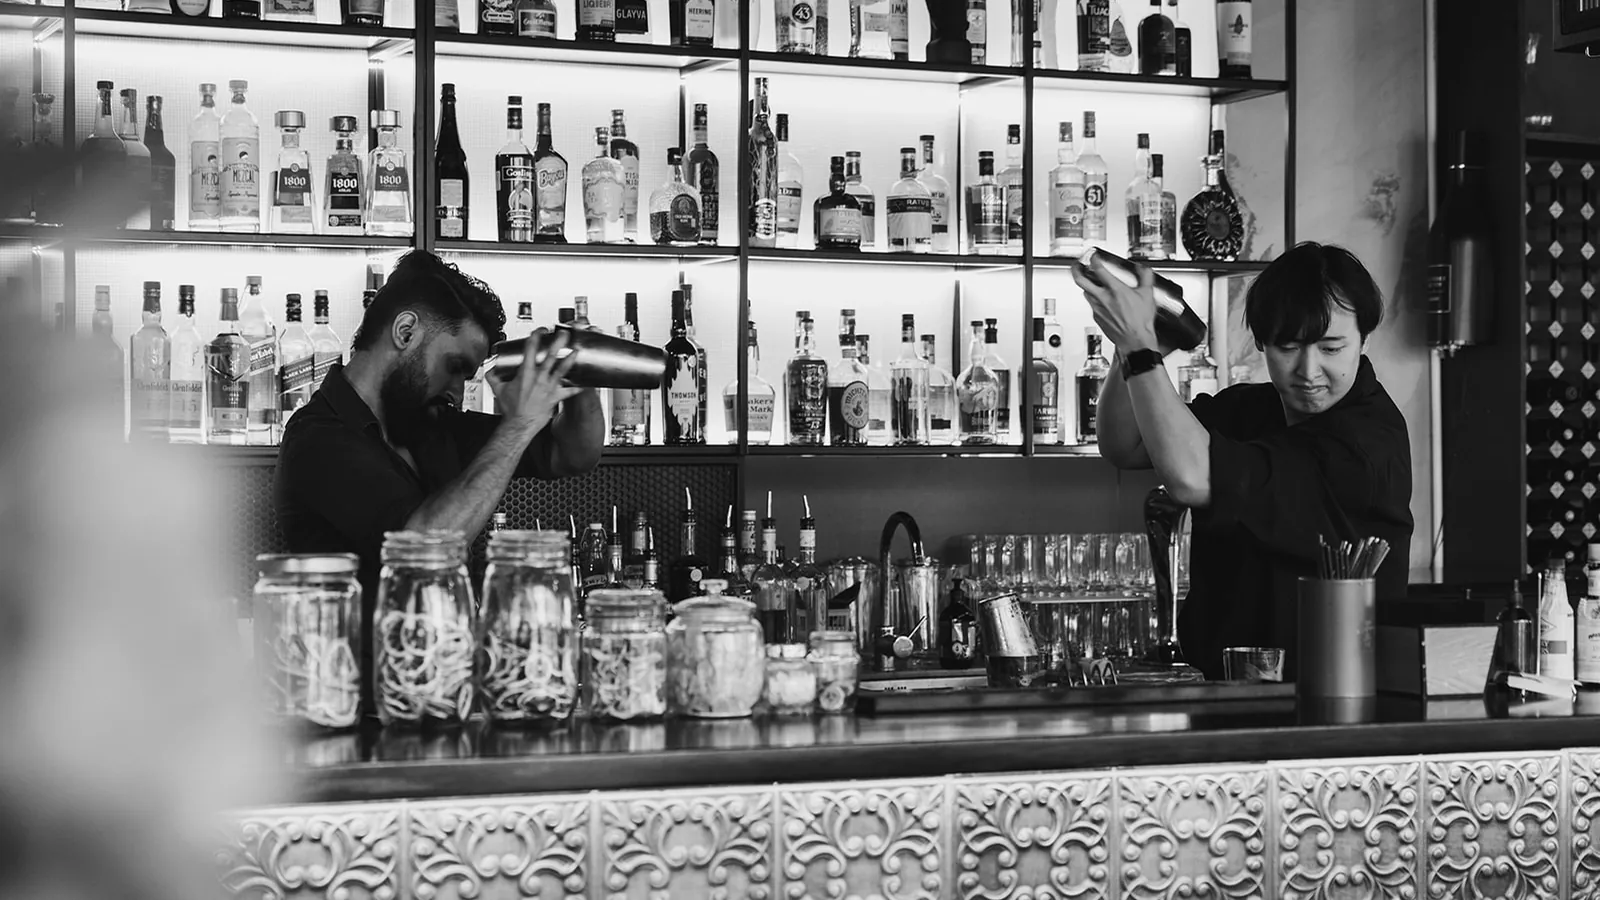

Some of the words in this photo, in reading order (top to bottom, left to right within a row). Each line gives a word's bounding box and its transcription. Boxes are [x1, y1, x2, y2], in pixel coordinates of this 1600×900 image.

[616, 9, 646, 20] GLAYVA
[688, 8, 712, 16] HEERING
[794, 7, 811, 20] 43
[232, 170, 256, 183] MEZCAL
[284, 176, 306, 186] 1800
[379, 175, 402, 185] 1800
[333, 178, 357, 189] 1800
[1087, 189, 1102, 203] 51
[671, 391, 696, 399] THOMSON
